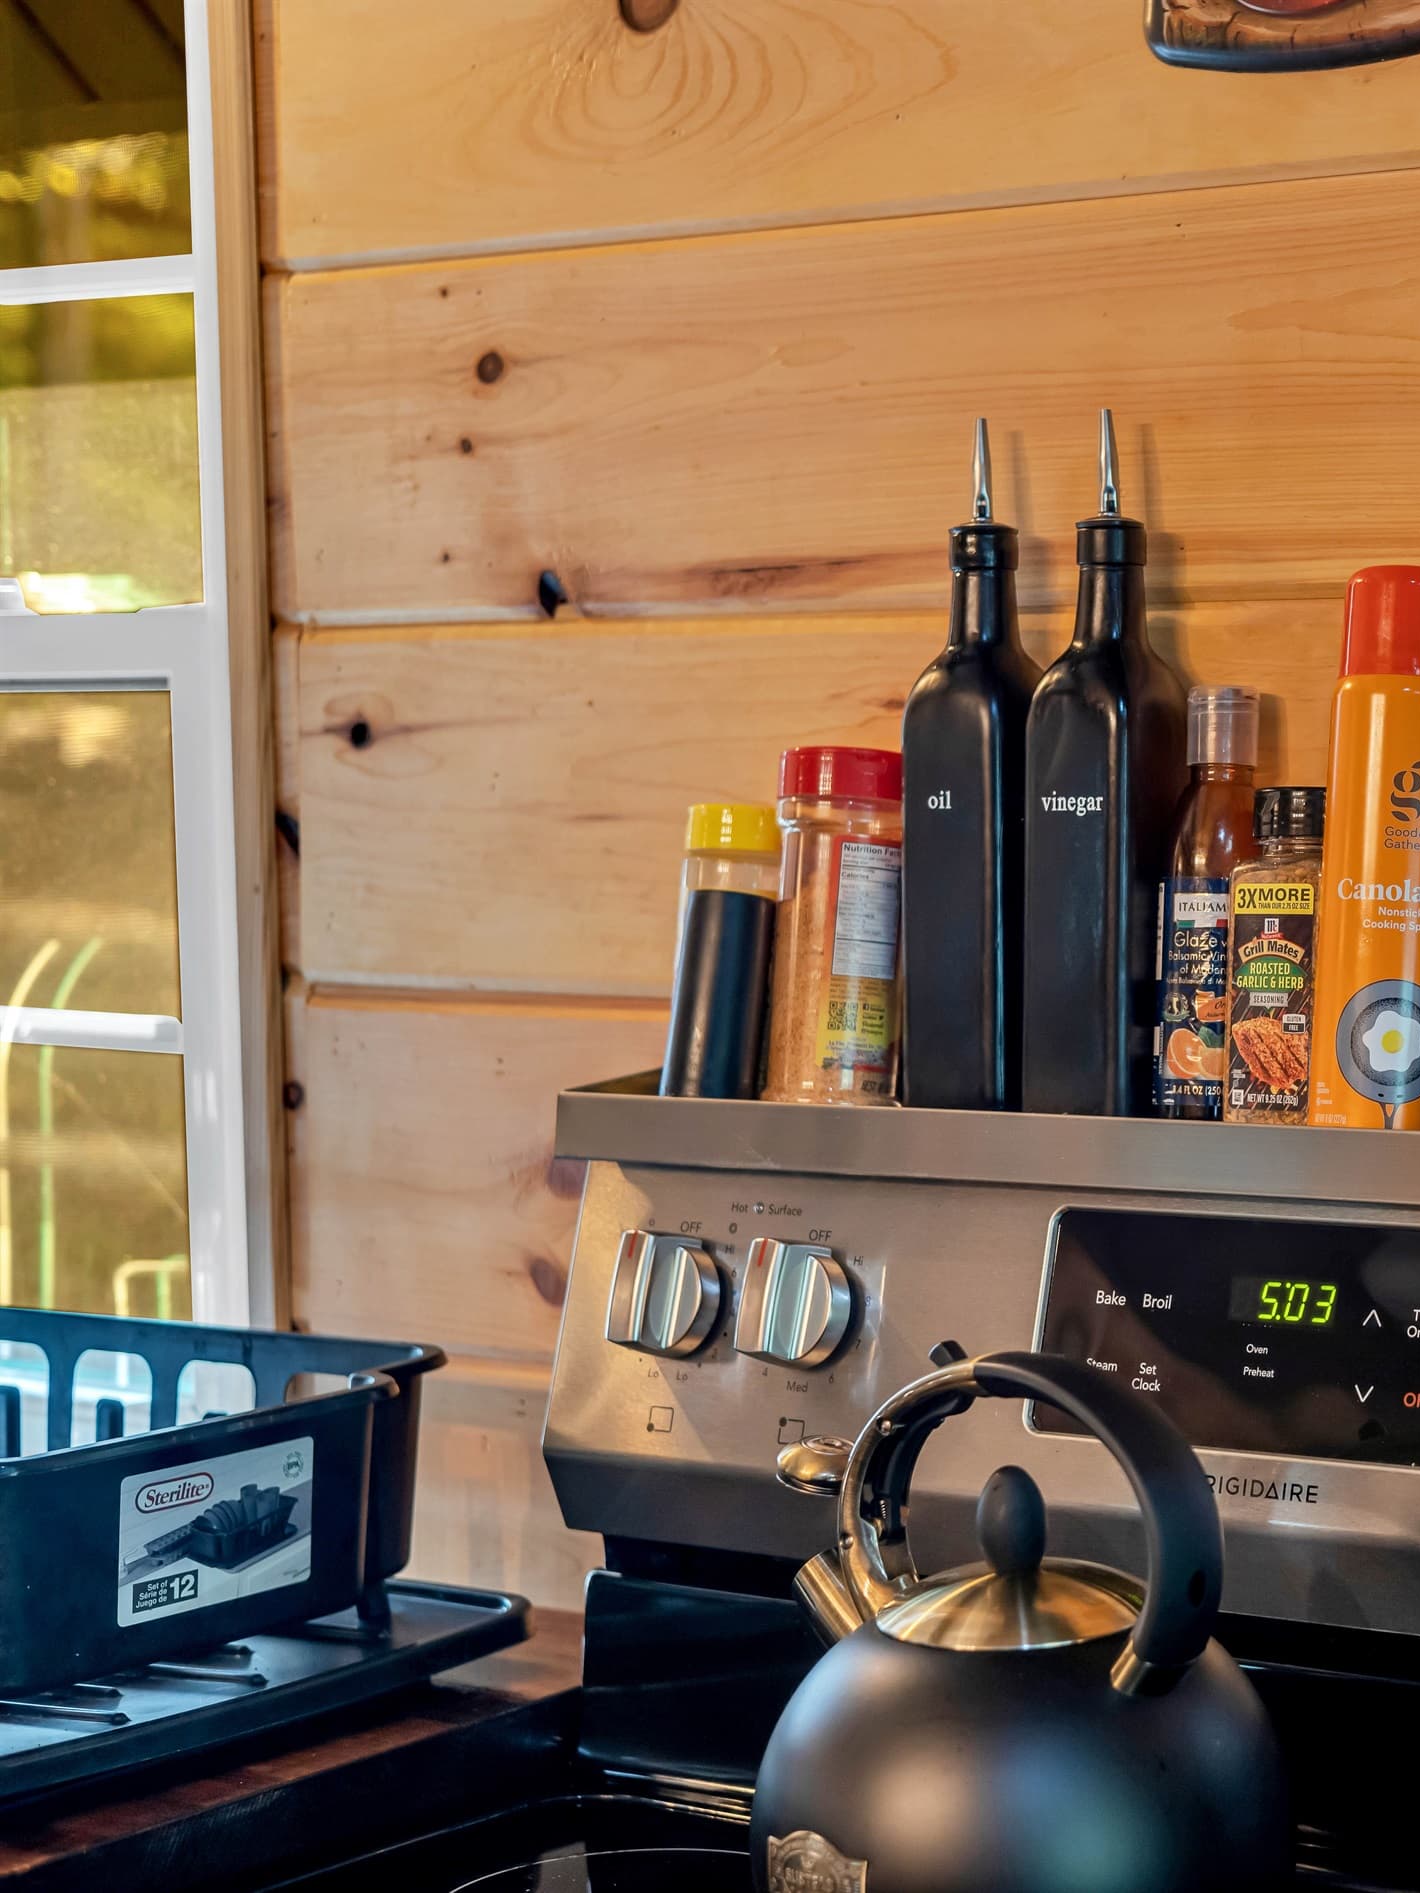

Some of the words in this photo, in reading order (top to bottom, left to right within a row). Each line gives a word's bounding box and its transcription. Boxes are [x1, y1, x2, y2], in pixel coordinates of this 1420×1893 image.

[927, 790, 952, 809] oil
[1041, 791, 1104, 817] vinegar
[843, 843, 882, 856] Nutrition
[1237, 888, 1257, 909] 3X
[1258, 888, 1311, 901] MORE
[1178, 901, 1227, 913] ITALIAM
[1258, 902, 1271, 910] THAN
[1272, 902, 1281, 910] OUR
[1362, 918, 1406, 932] Cooking
[1174, 930, 1218, 948] Glaze
[1168, 950, 1208, 961] Balsamic
[1243, 940, 1265, 958] Grill
[1267, 940, 1299, 959] Mates
[1179, 962, 1189, 974] of
[1250, 962, 1290, 975] ROASTED
[1236, 975, 1268, 988] GARLIC
[1270, 976, 1277, 988] &
[1278, 976, 1304, 990] HERB
[1253, 994, 1285, 1004] SEASONING
[1286, 1015, 1301, 1023] GLUTEN
[1183, 1084, 1191, 1095] FL
[1192, 1085, 1203, 1096] OZ
[1247, 1093, 1256, 1103] NET
[1257, 1094, 1265, 1103] WT
[731, 1203, 748, 1213] Hot
[768, 1203, 802, 1217] Surface
[680, 1220, 702, 1233] OFF
[808, 1229, 832, 1242] OFF
[853, 1255, 864, 1267] Hi
[1095, 1289, 1127, 1306] Bake
[1142, 1293, 1173, 1310] Broil
[1246, 1343, 1269, 1355] Oven
[648, 1367, 659, 1378] Lo
[1138, 1361, 1157, 1376] Set
[1243, 1366, 1275, 1379] Preheat
[827, 1372, 835, 1385] 6
[1131, 1377, 1161, 1393] Clock
[786, 1380, 808, 1394] Med
[144, 1481, 205, 1509] Sterilite
[1205, 1474, 1319, 1504] RIGIDAIRE
[147, 1583, 160, 1592] Set
[160, 1580, 168, 1589] of
[158, 1588, 168, 1597] de
[169, 1574, 196, 1600] 12
[135, 1597, 157, 1609] Juego
[158, 1593, 168, 1602] de
